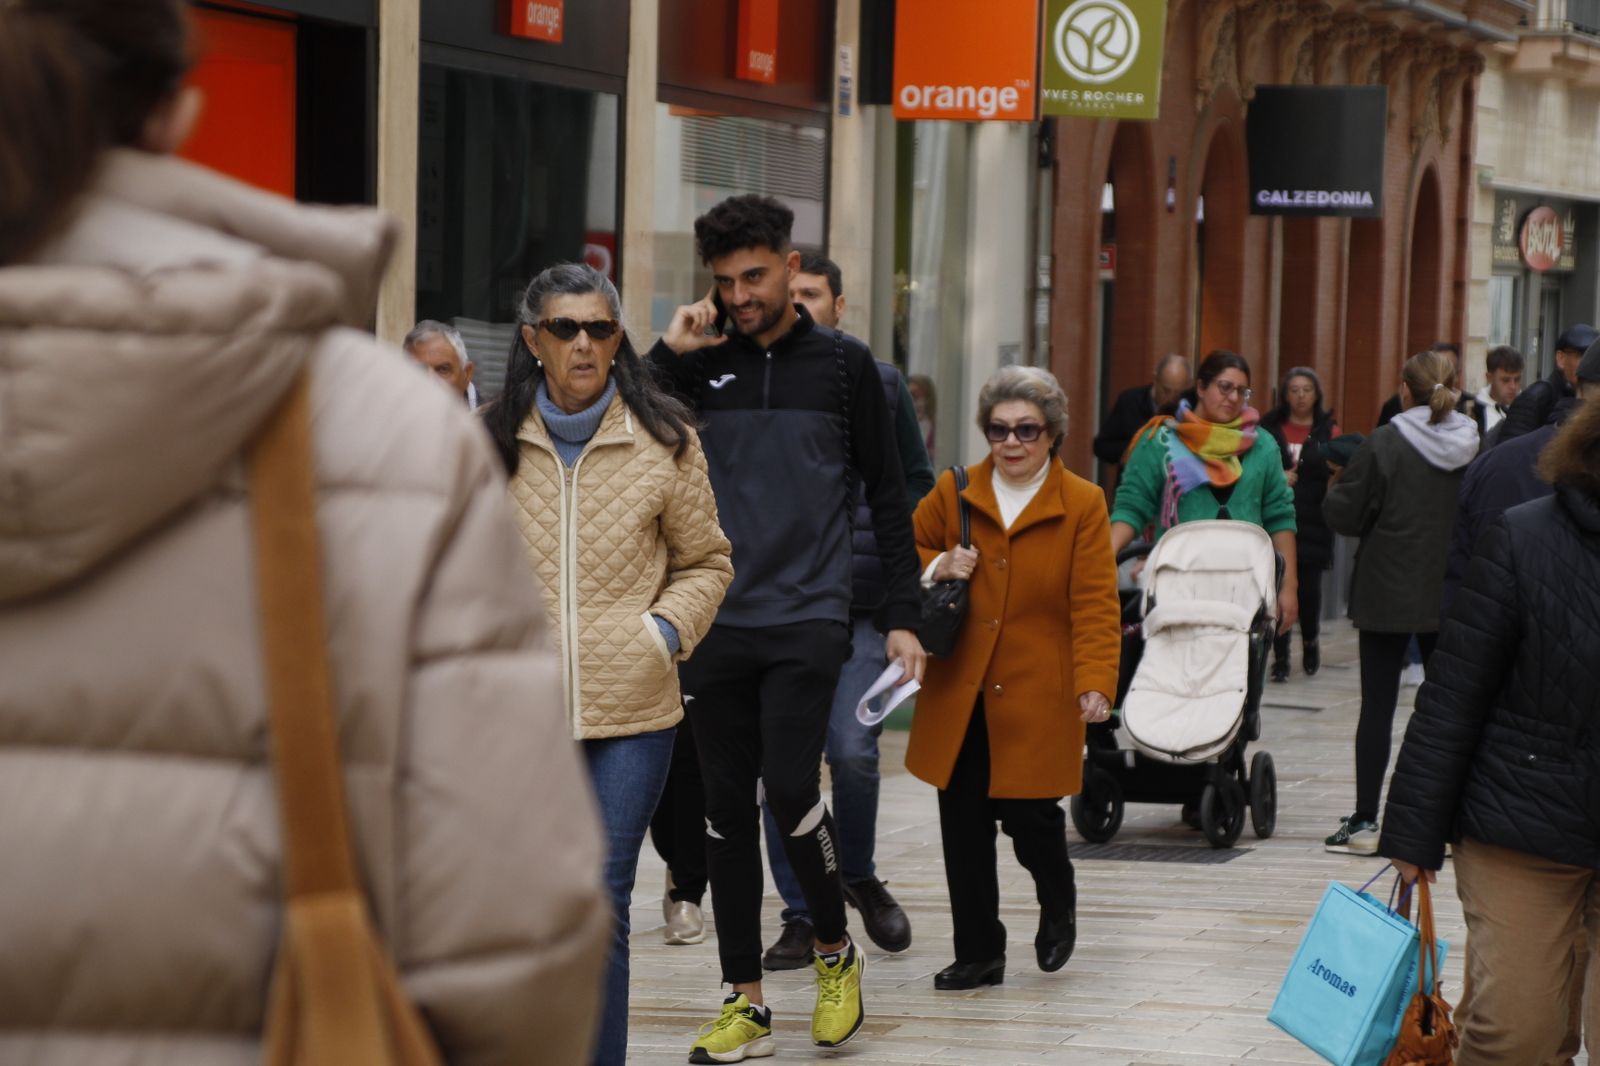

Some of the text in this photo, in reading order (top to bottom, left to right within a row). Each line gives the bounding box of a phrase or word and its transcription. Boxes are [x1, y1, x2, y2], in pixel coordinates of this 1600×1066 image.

[527, 2, 560, 34] orange
[900, 85, 1018, 116] orange
[1041, 88, 1144, 103] YVES ROCHER
[1257, 189, 1373, 206] CALZEDONIA
[817, 825, 837, 874] Joma
[1307, 958, 1357, 998] Aromas
